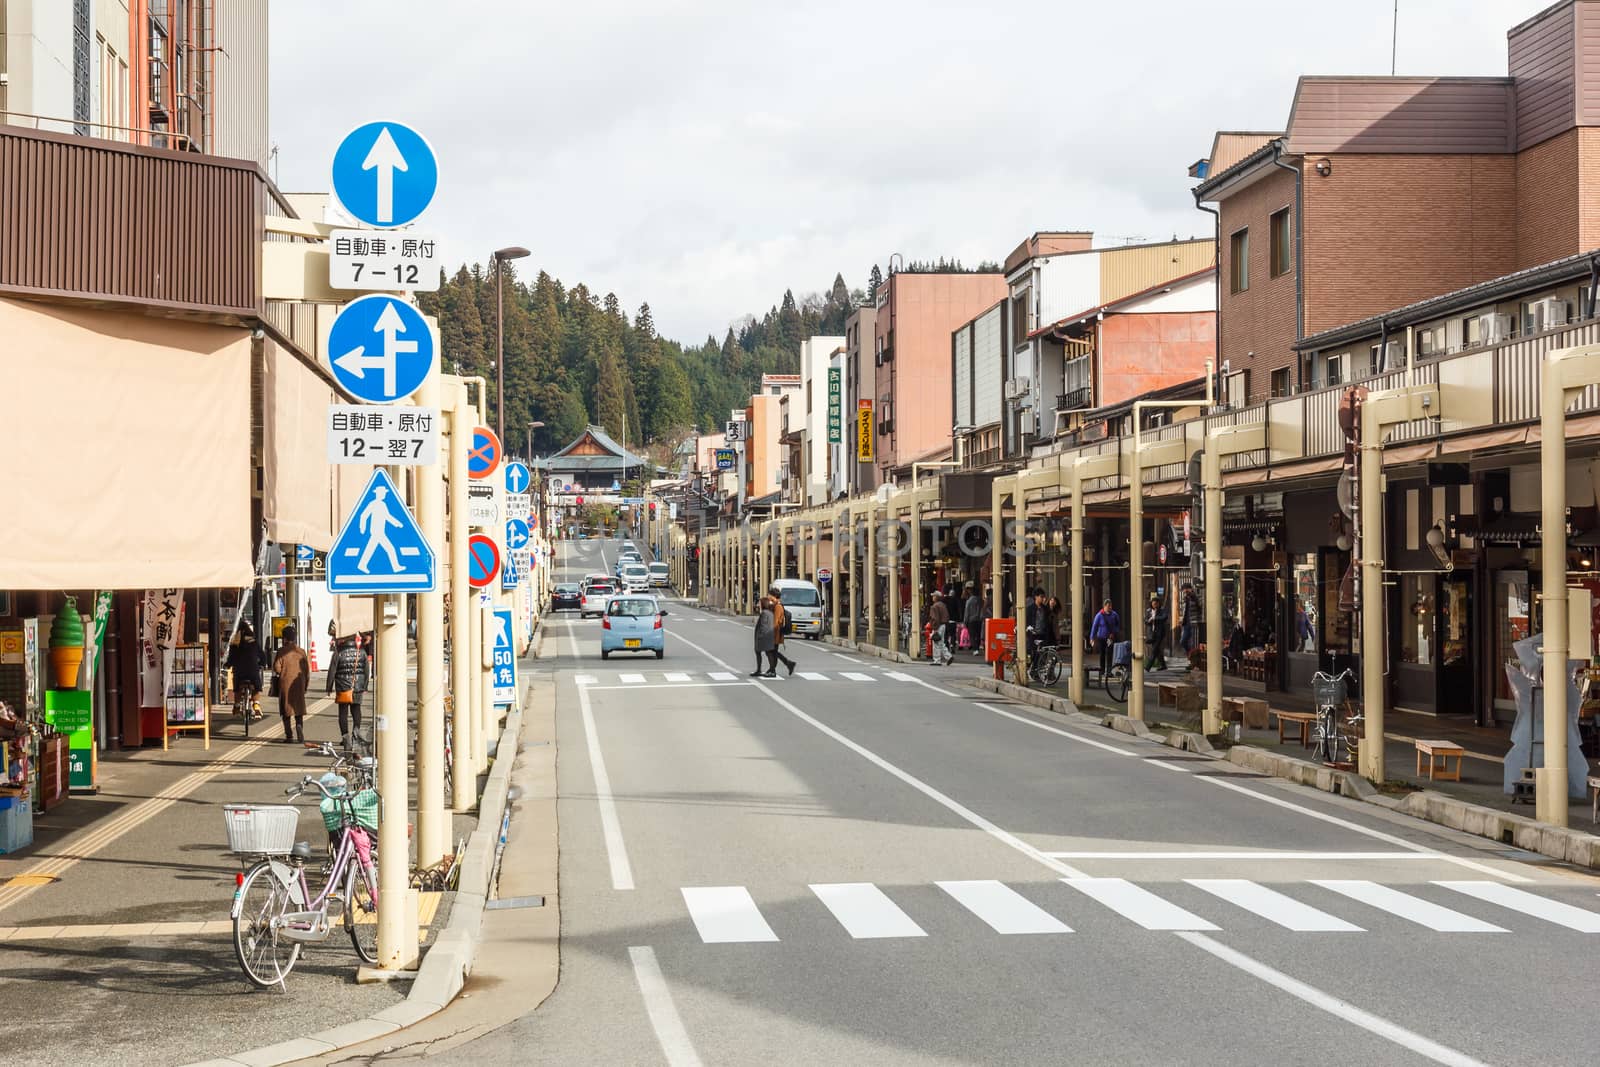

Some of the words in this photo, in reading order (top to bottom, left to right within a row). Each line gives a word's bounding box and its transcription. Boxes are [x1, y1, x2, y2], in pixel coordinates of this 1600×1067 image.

[335, 237, 436, 259] 自動車・原付
[332, 411, 433, 433] 自動車・原付
